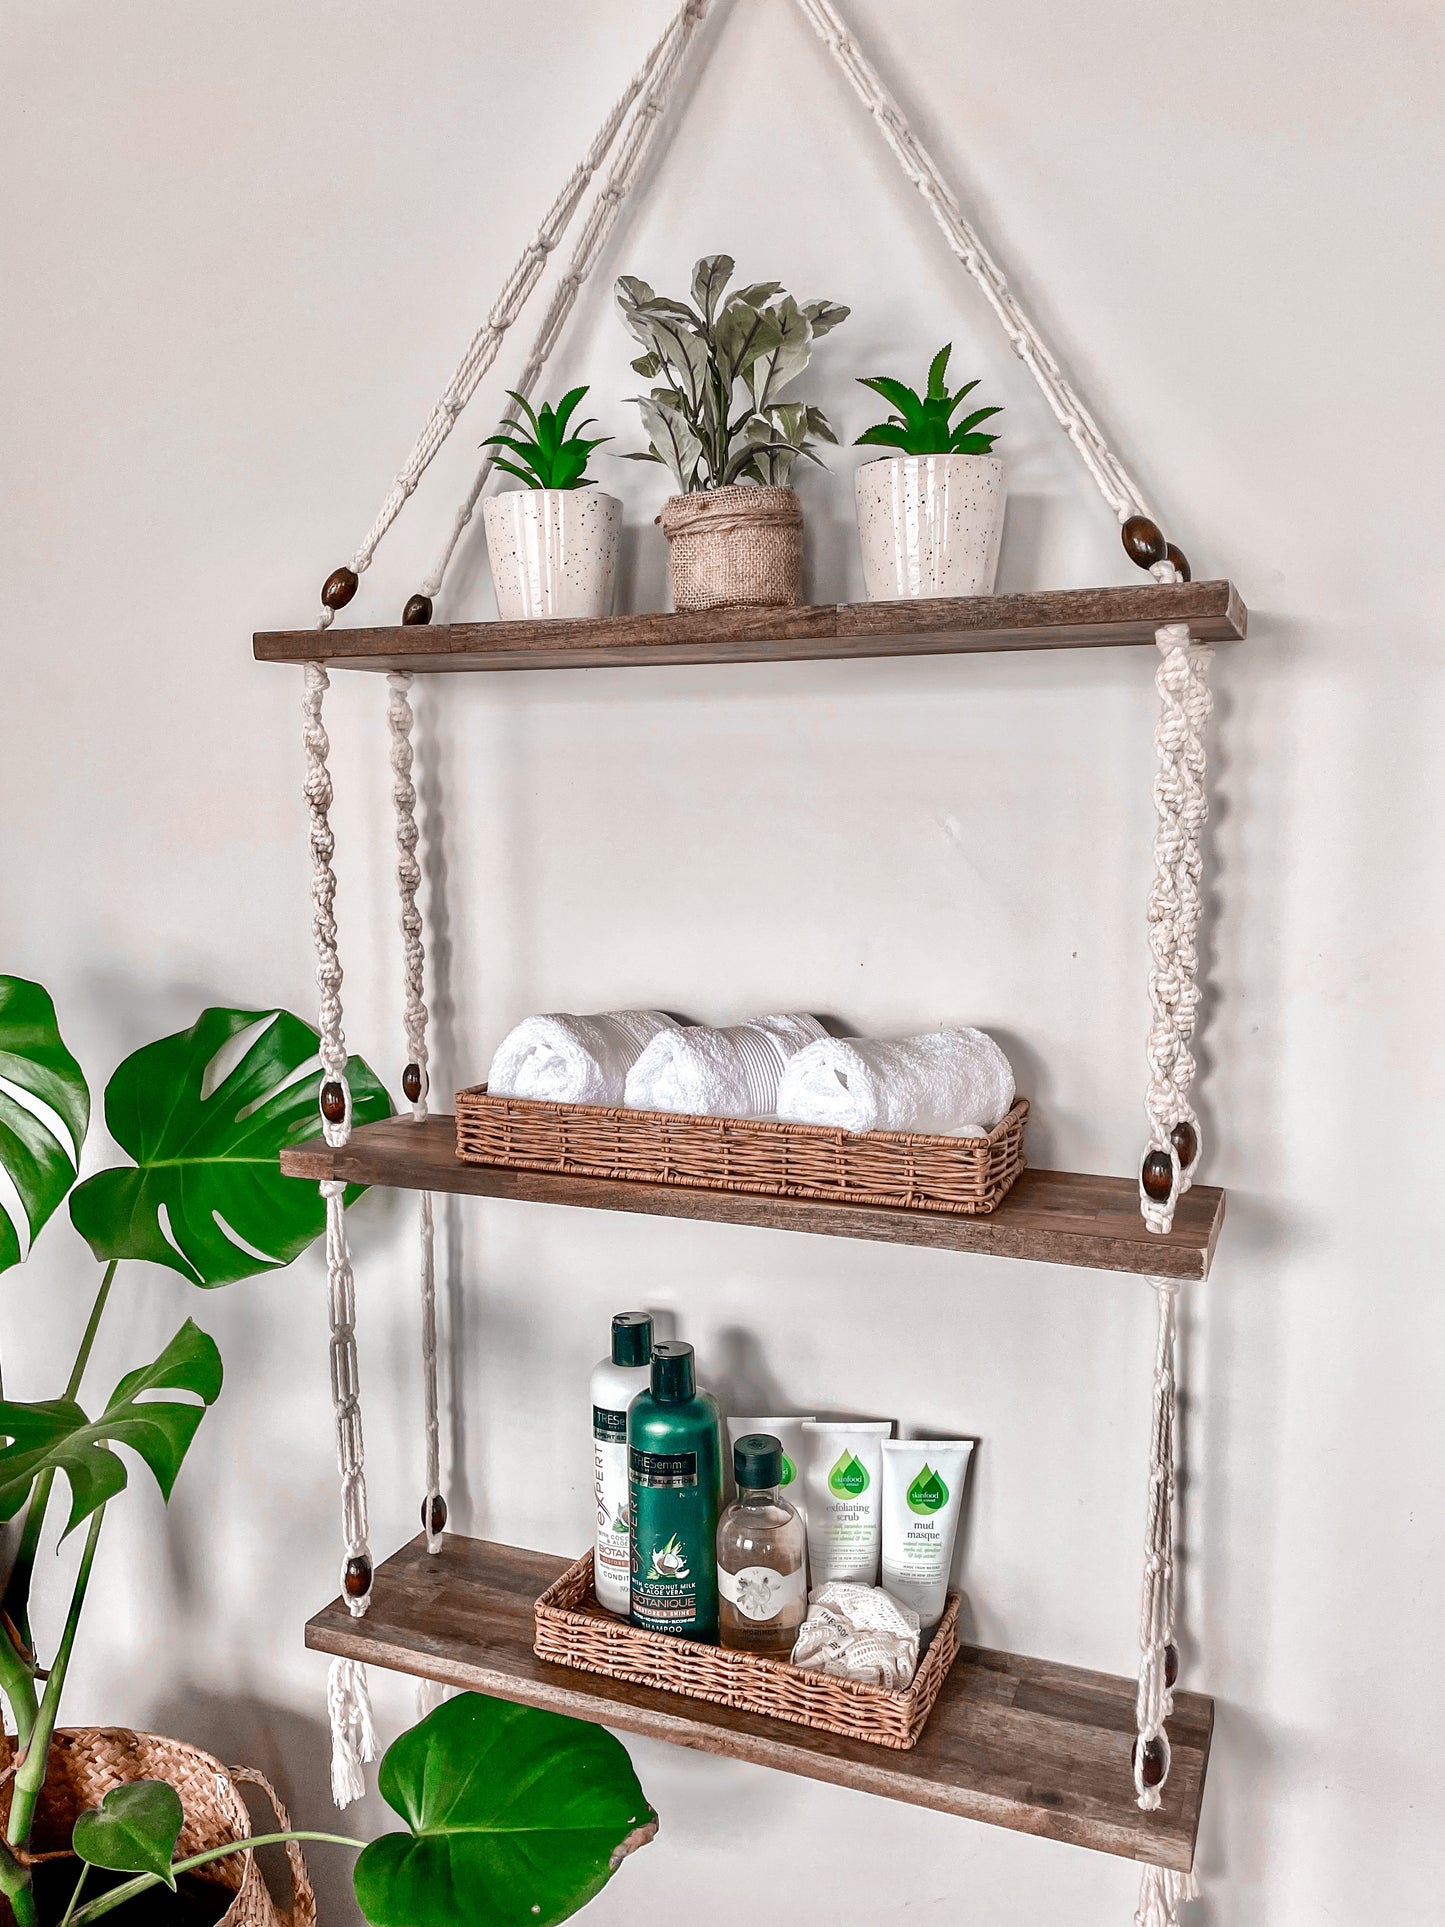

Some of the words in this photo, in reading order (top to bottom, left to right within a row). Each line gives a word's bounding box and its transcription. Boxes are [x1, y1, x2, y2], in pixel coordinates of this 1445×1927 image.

[654, 1477, 694, 1486] SELECTION
[834, 1474, 862, 1483] skinfood
[912, 1491, 939, 1500] skinfood
[826, 1502, 870, 1515] exfoliating
[836, 1512, 860, 1521] scrub
[914, 1520, 934, 1530] mud
[907, 1531, 940, 1541] masque
[632, 1592, 696, 1608] BOTANIQUE
[820, 1611, 836, 1625] THE
[641, 1622, 683, 1633] SHAMPOO
